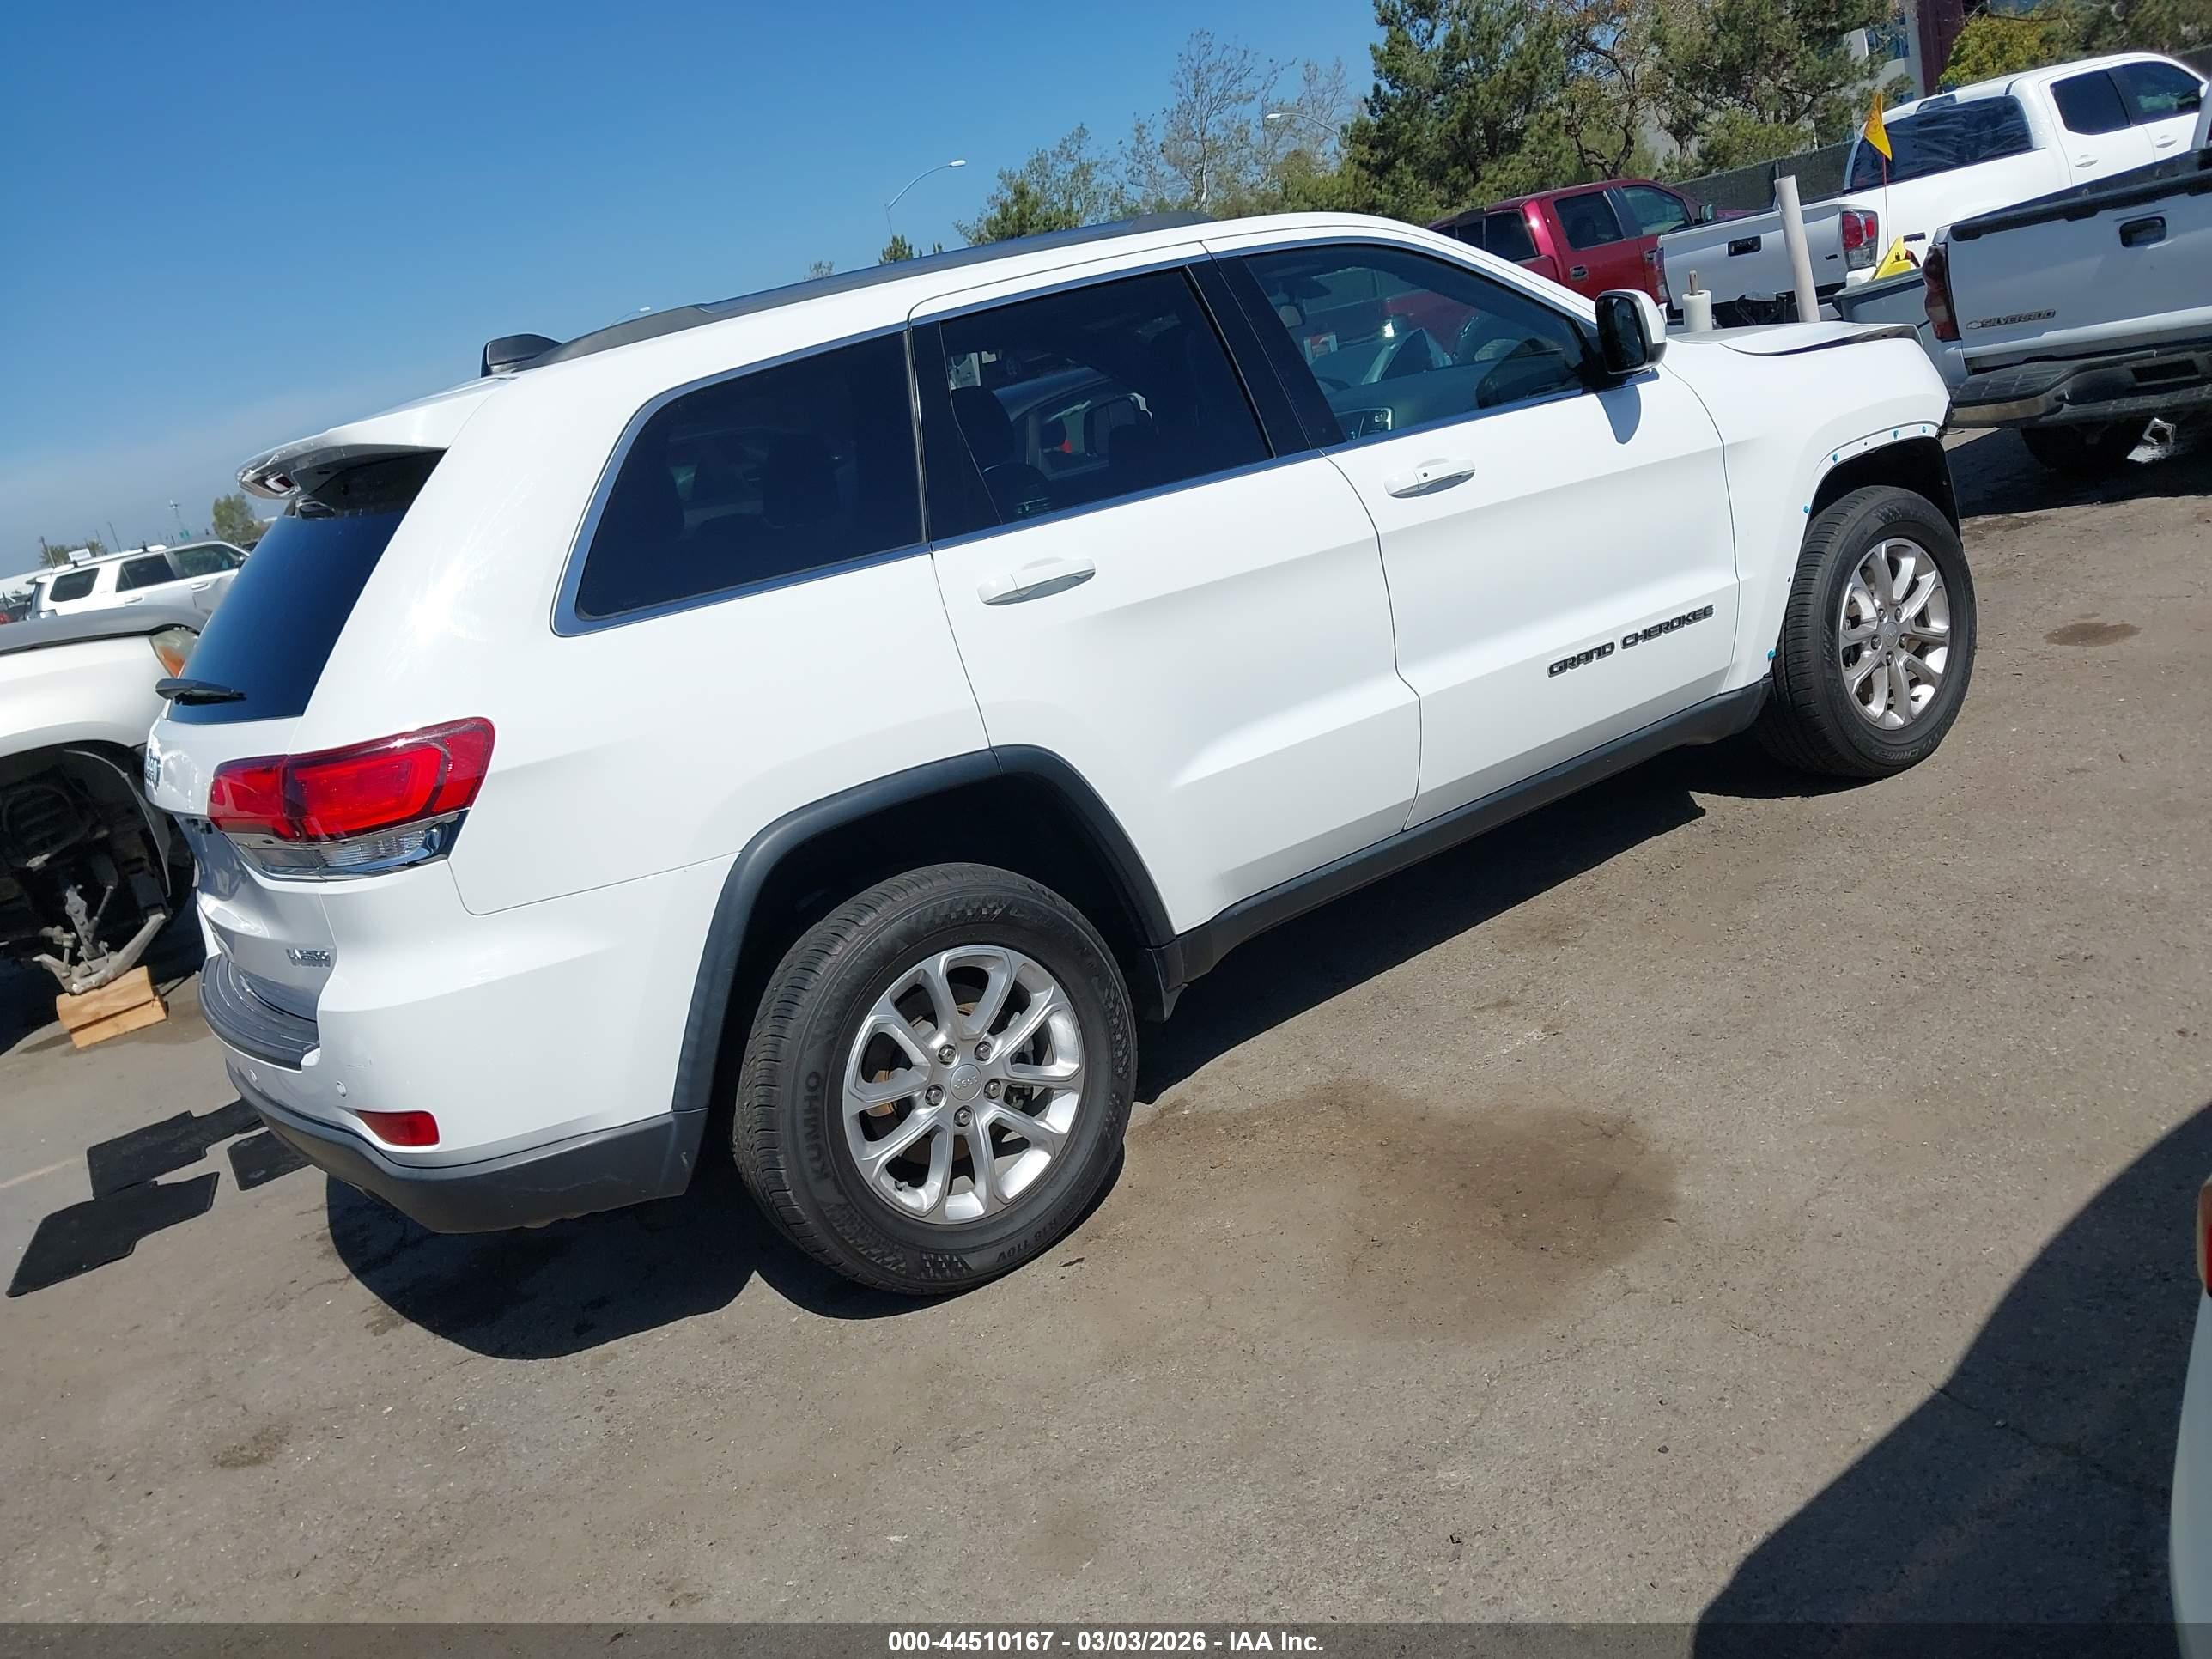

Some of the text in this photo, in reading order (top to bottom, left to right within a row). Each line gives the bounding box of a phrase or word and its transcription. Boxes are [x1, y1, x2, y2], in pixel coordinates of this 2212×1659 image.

[1981, 309, 2056, 327] SILVERADO
[1548, 604, 1714, 678] GRAND CHEROKEE
[803, 1071, 832, 1181] KUMHO
